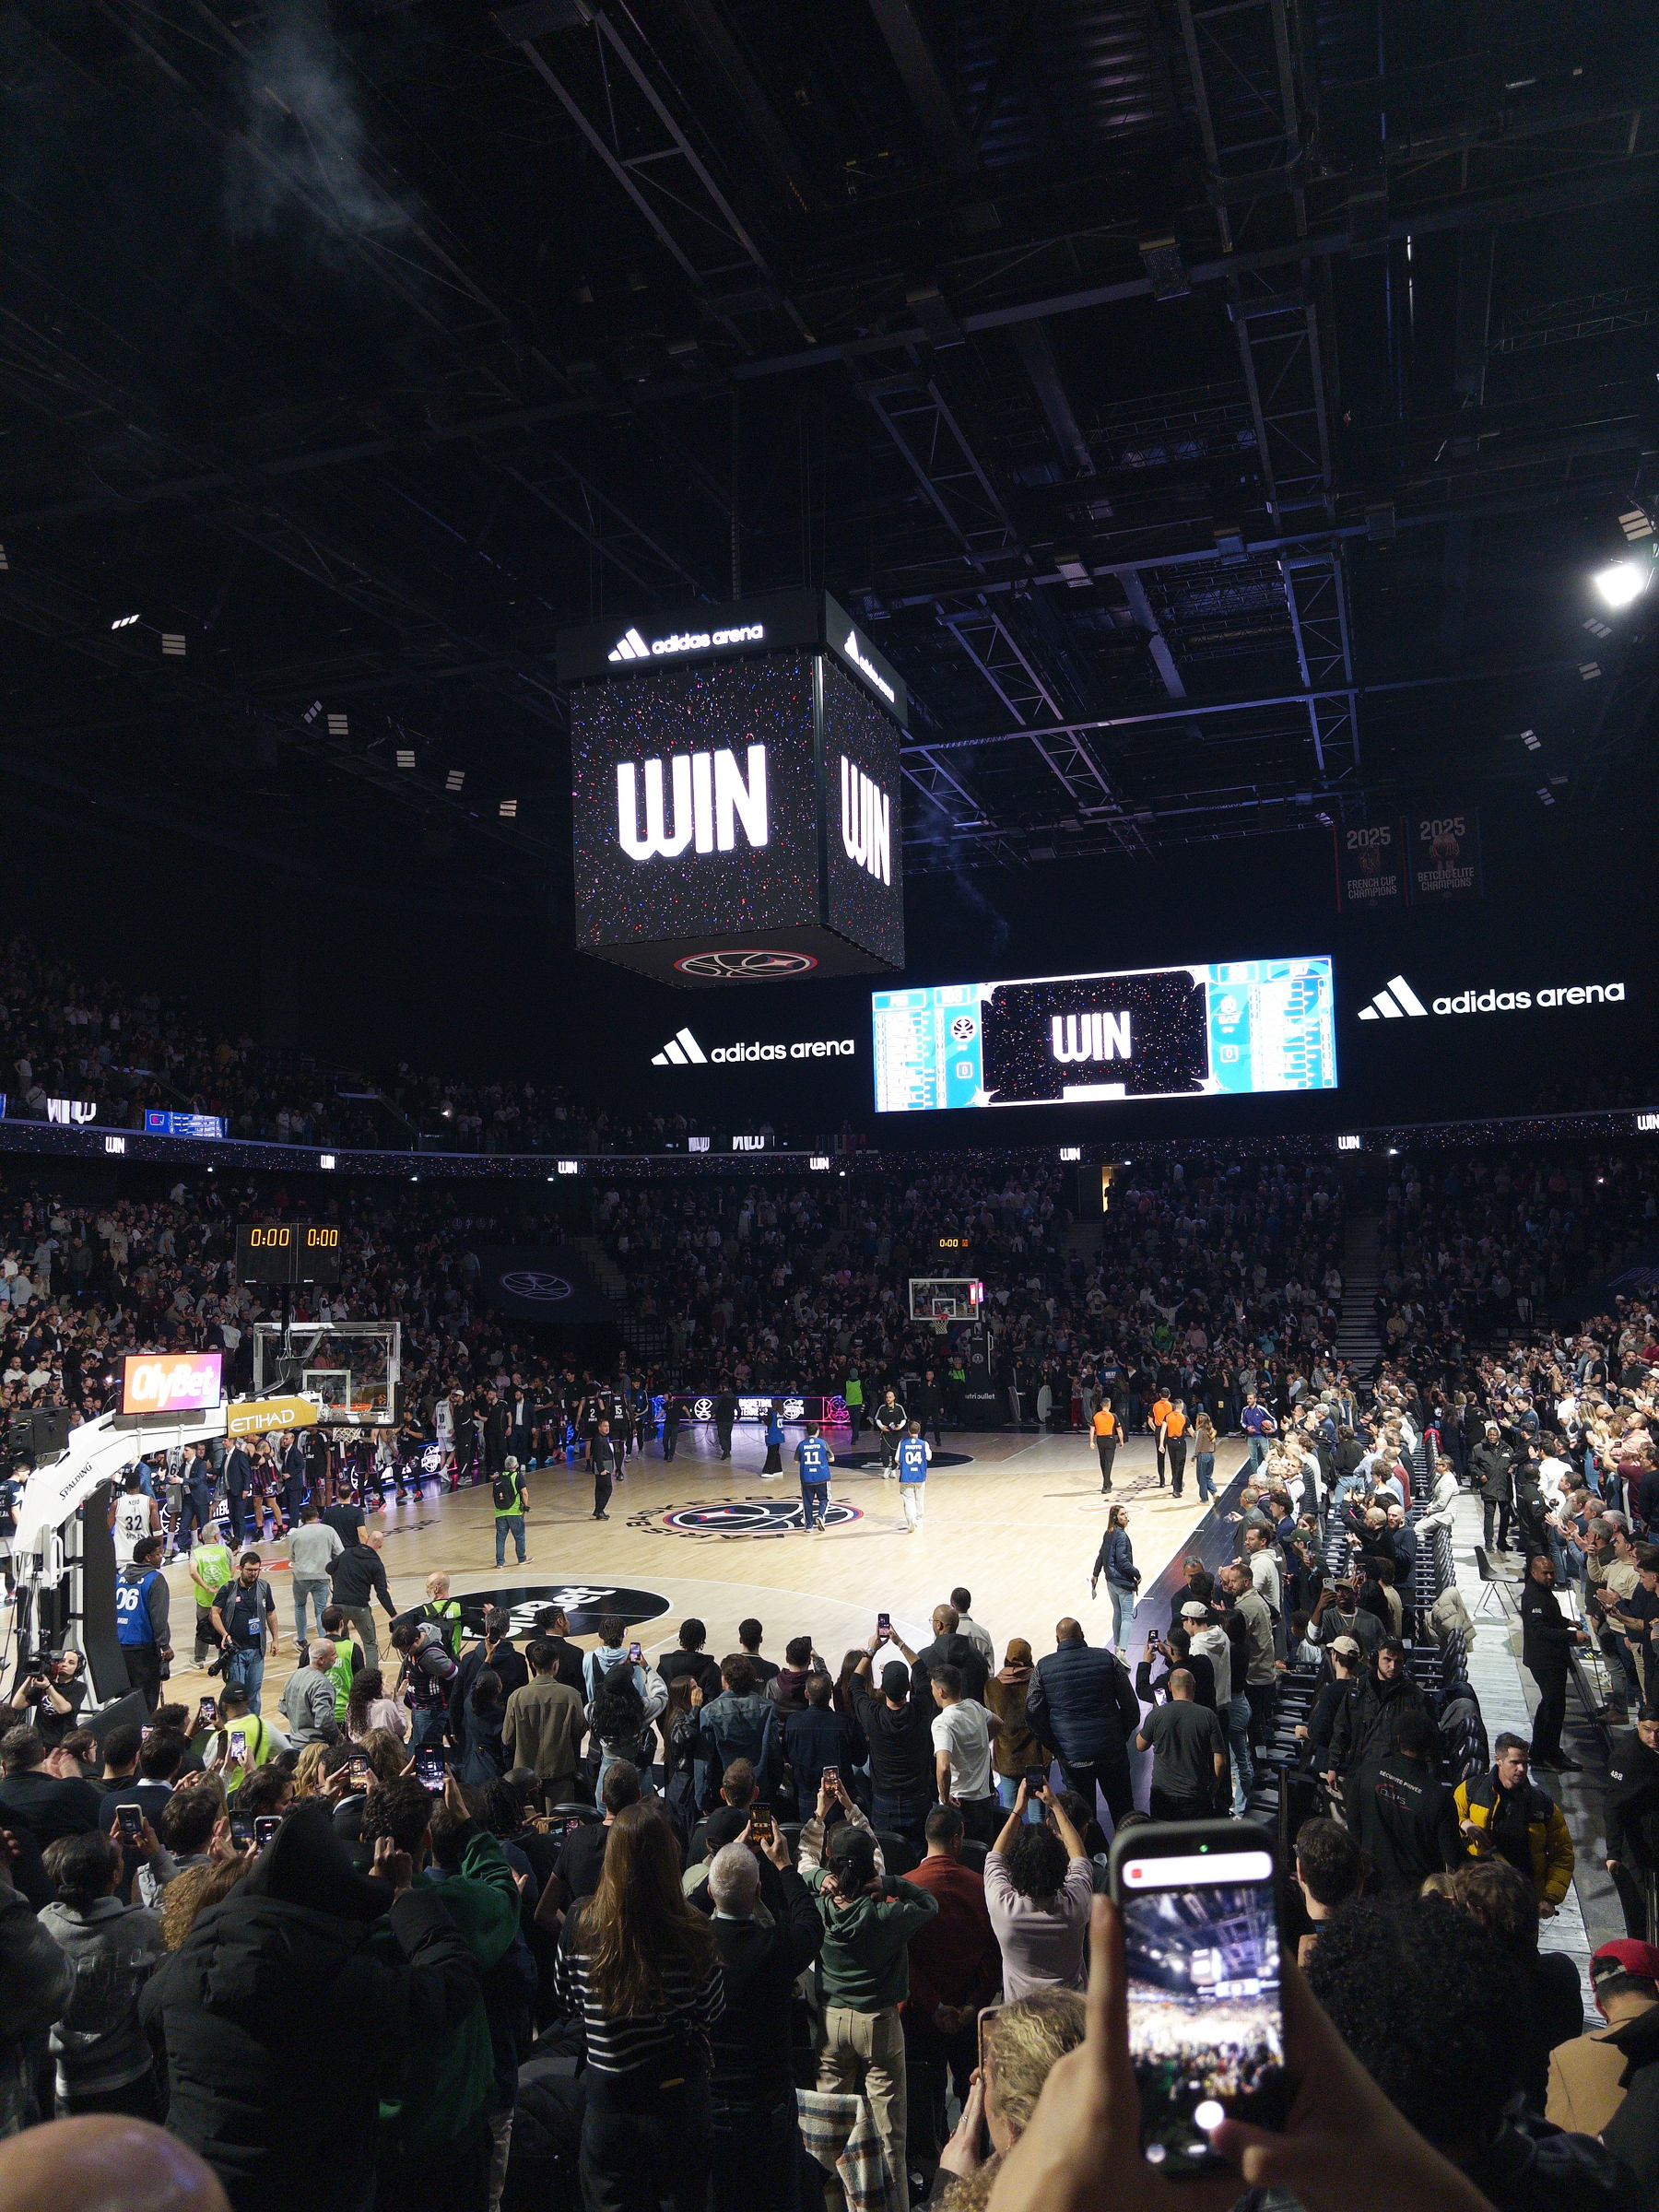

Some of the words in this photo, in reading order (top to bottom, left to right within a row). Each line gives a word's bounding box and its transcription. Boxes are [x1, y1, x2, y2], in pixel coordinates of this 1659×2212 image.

[652, 631, 711, 655] adidas
[712, 623, 764, 645] arena
[617, 744, 769, 861] WIN
[841, 754, 891, 887] WIN
[1419, 818, 1465, 841] 2025
[1347, 827, 1391, 849] 2025
[1418, 870, 1451, 882] BETCLIC
[1452, 867, 1475, 878] ELITE
[1347, 877, 1379, 890] FRENCH
[1380, 876, 1397, 887] CUP
[1421, 877, 1472, 891] CHAMPIONS
[1347, 886, 1397, 900] CHAMPIONS
[1432, 989, 1531, 1015] adidas
[1535, 982, 1626, 1008] arena
[1053, 1011, 1132, 1064] WIN
[711, 1042, 787, 1064] adidas
[790, 1038, 855, 1058] arena
[105, 1135, 125, 1154] WIN
[1337, 1135, 1360, 1150] WIN
[1060, 1147, 1081, 1161] WIN
[320, 1154, 336, 1170] WIN
[558, 1160, 578, 1174] WIN
[809, 1157, 830, 1172] WIN
[251, 1228, 289, 1247] 0:00
[308, 1229, 338, 1247] 0:00
[939, 1239, 959, 1248] 0:00
[131, 1363, 214, 1407] OlyBet
[590, 1408, 595, 1418] 2
[614, 1405, 623, 1415] 15
[230, 1408, 295, 1433] ETIHAD
[439, 1413, 445, 1423] 10
[804, 1451, 821, 1465] 11
[905, 1451, 923, 1465] 04
[170, 1463, 177, 1475] 6
[59, 1462, 93, 1500] SPALDING
[125, 1514, 143, 1531] 32
[641, 1527, 785, 1540] PARIS
[116, 1587, 139, 1611] 06
[1610, 1770, 1623, 1781] 488
